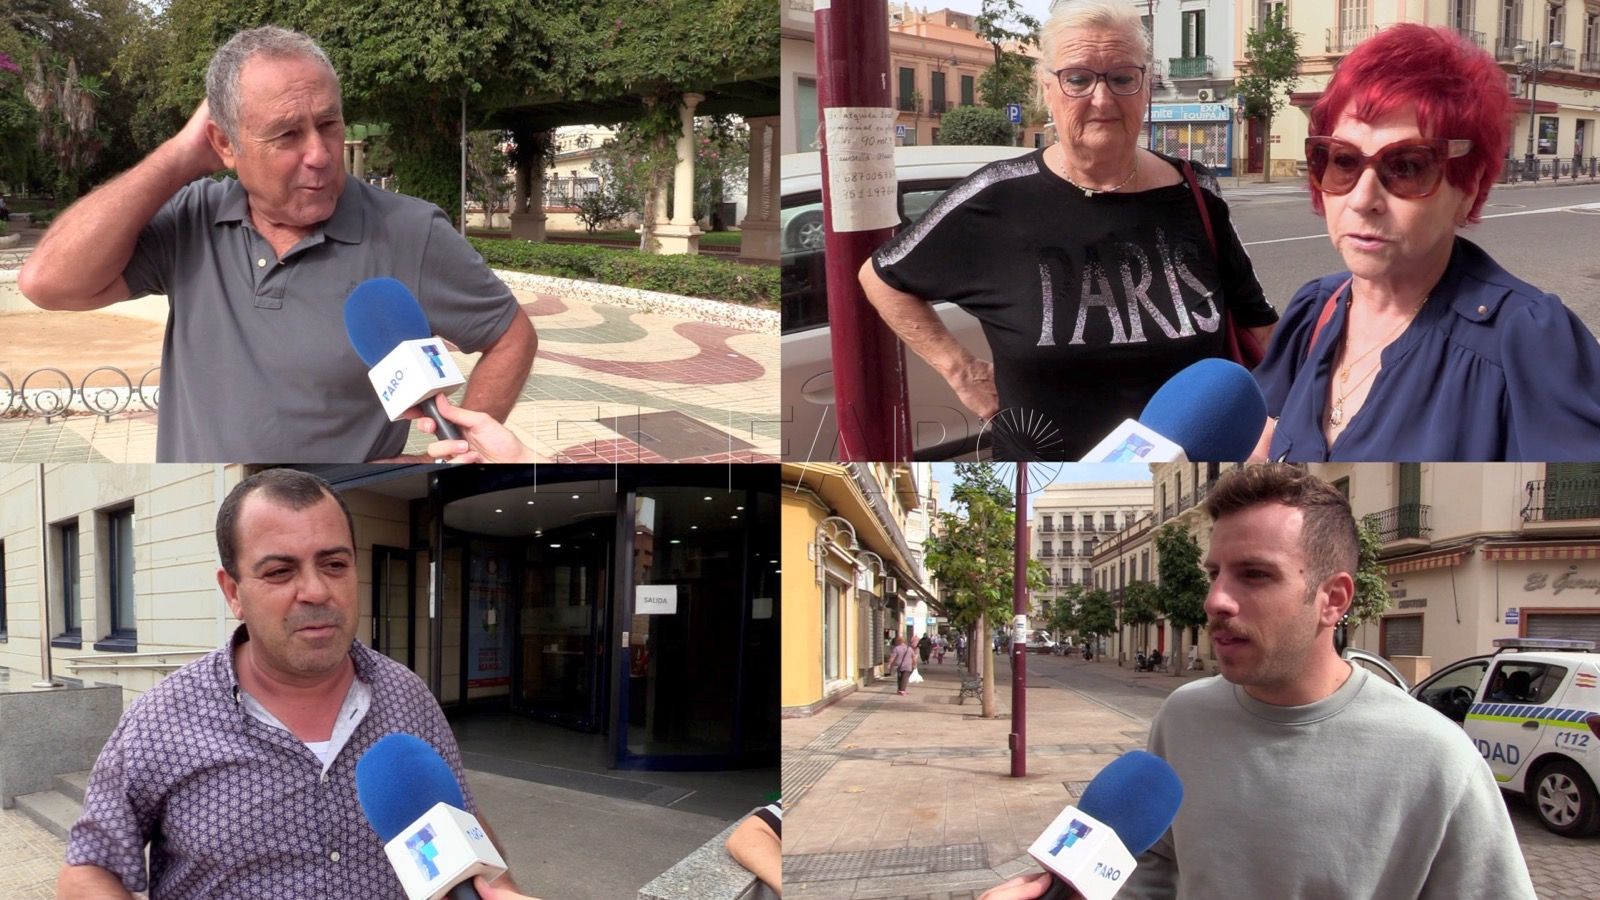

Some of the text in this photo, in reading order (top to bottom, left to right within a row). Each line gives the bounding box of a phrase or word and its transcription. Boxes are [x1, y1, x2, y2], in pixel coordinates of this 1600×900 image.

[1010, 106, 1018, 120] P
[1183, 112, 1227, 120] EQUIPAJE
[861, 135, 875, 147] 90
[644, 597, 668, 605] SALIDA
[1563, 732, 1590, 748] 112
